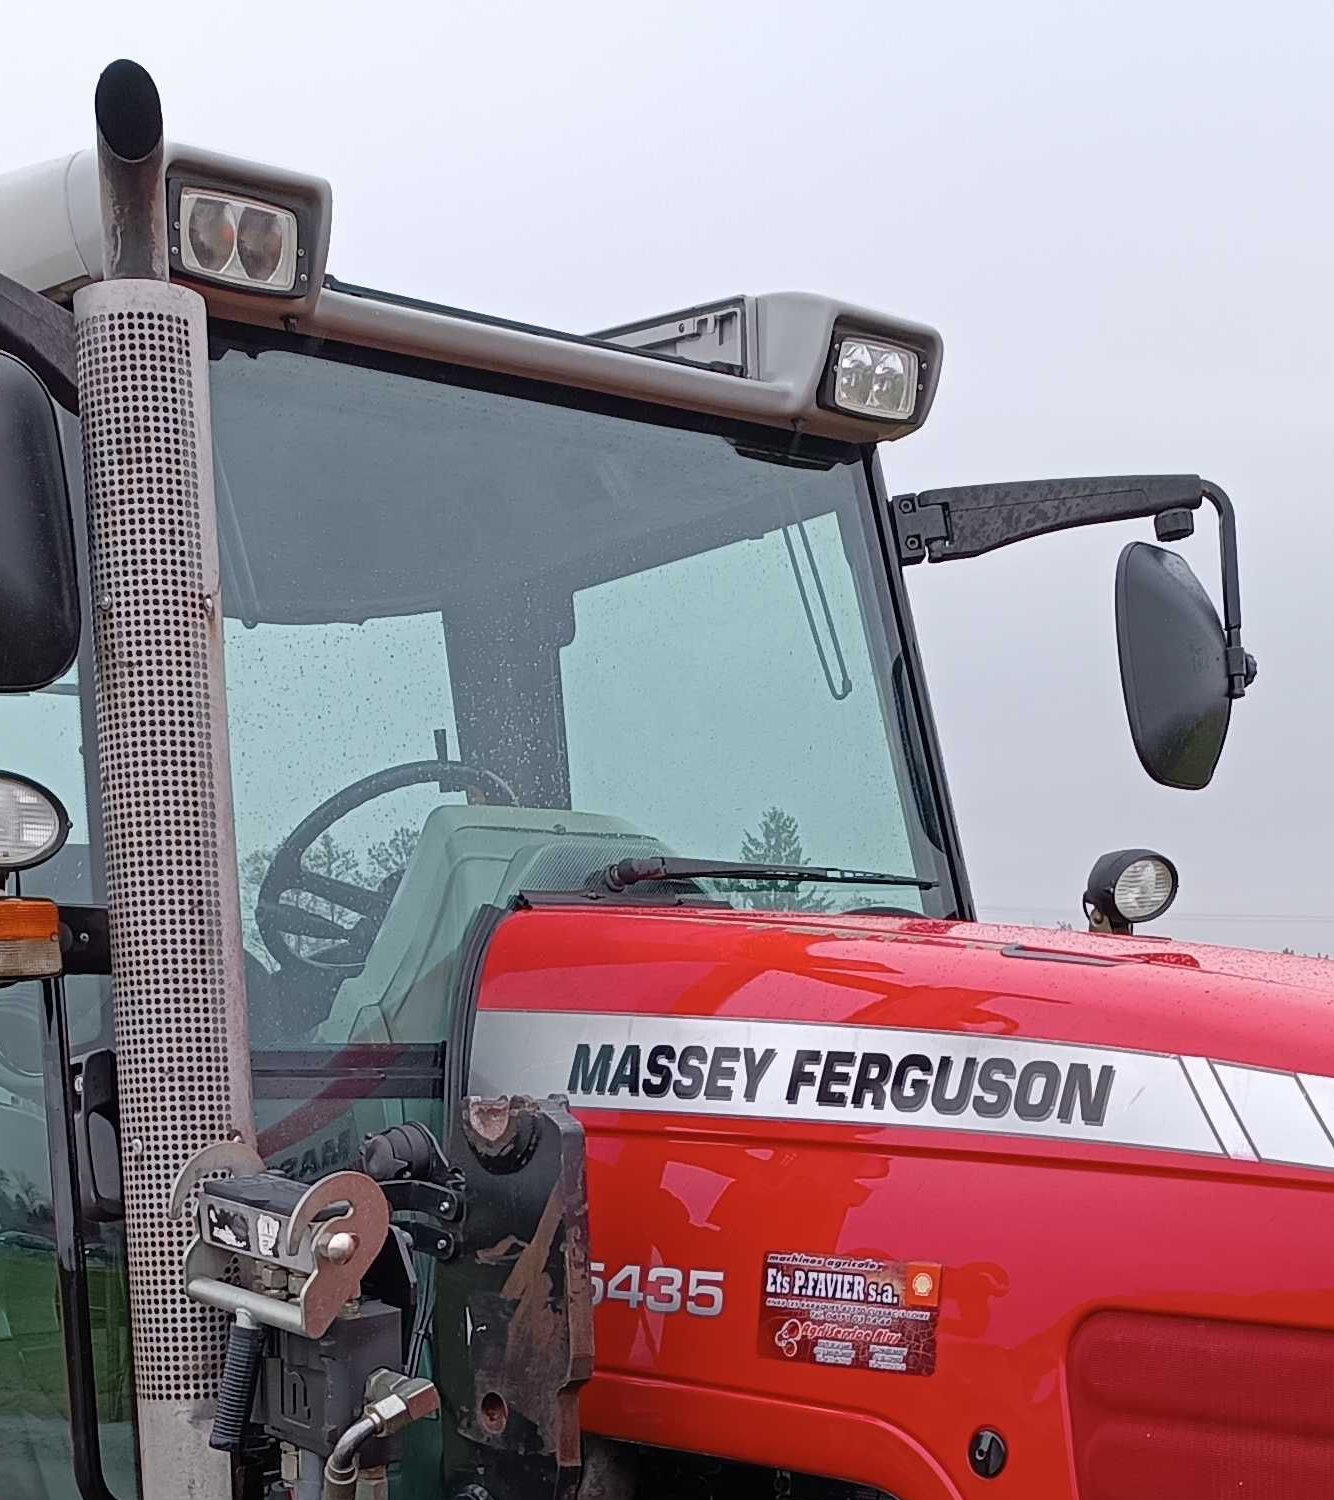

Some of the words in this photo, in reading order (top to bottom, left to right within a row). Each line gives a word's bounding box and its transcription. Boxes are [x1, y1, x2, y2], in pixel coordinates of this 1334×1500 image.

[568, 1043, 777, 1102] MASSEY
[786, 1049, 1115, 1127] FERGUSON
[766, 1268, 790, 1294] Ets
[793, 1270, 865, 1300] P.FAVIER
[868, 1283, 899, 1304] s.a.
